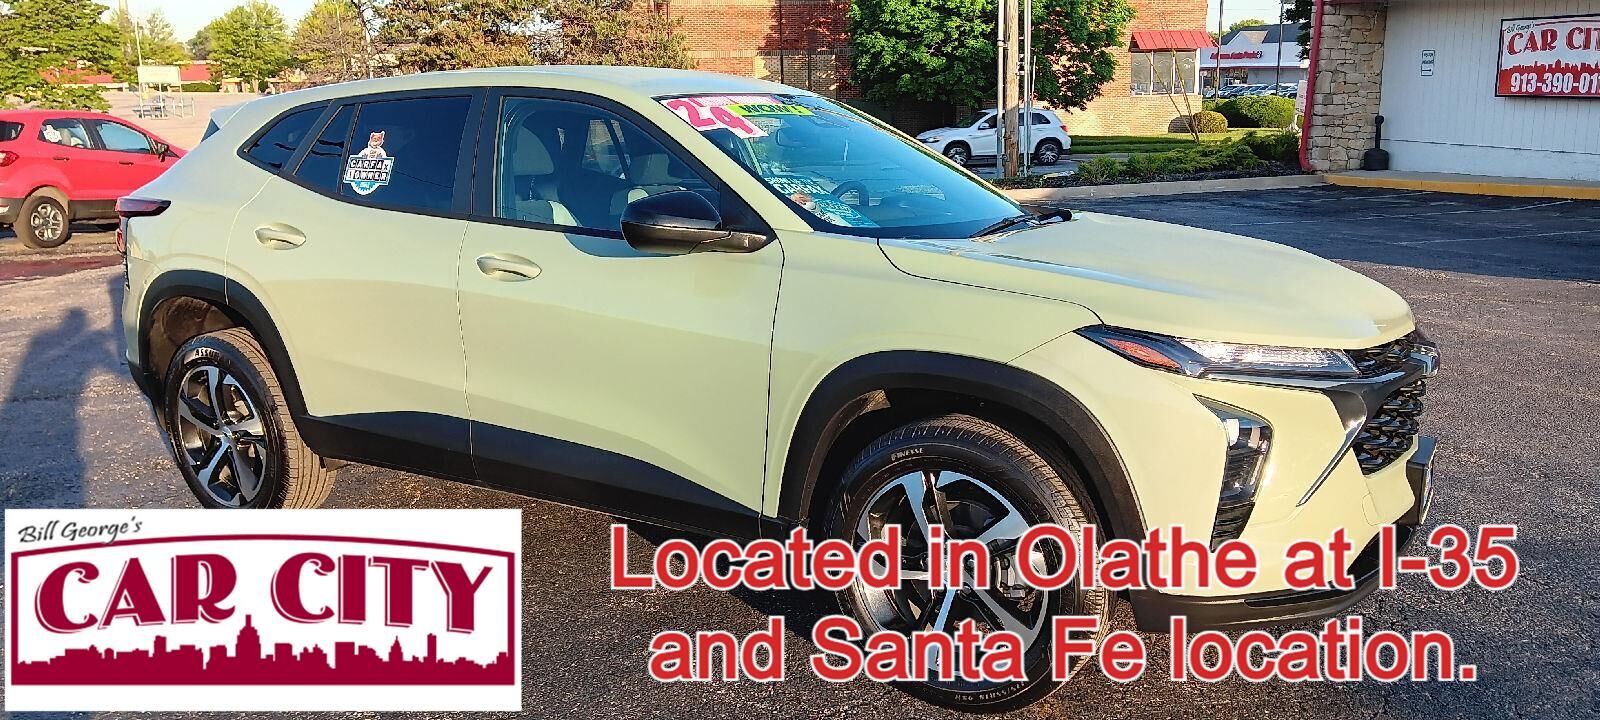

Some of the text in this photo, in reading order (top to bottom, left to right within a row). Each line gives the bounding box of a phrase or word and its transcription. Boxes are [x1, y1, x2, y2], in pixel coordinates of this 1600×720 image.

[1507, 29, 1558, 56] CAR
[1510, 72, 1600, 94] 913-390-01
[350, 158, 389, 170] CARFAX
[353, 170, 388, 182] OWNER
[774, 184, 831, 195] CARFAX
